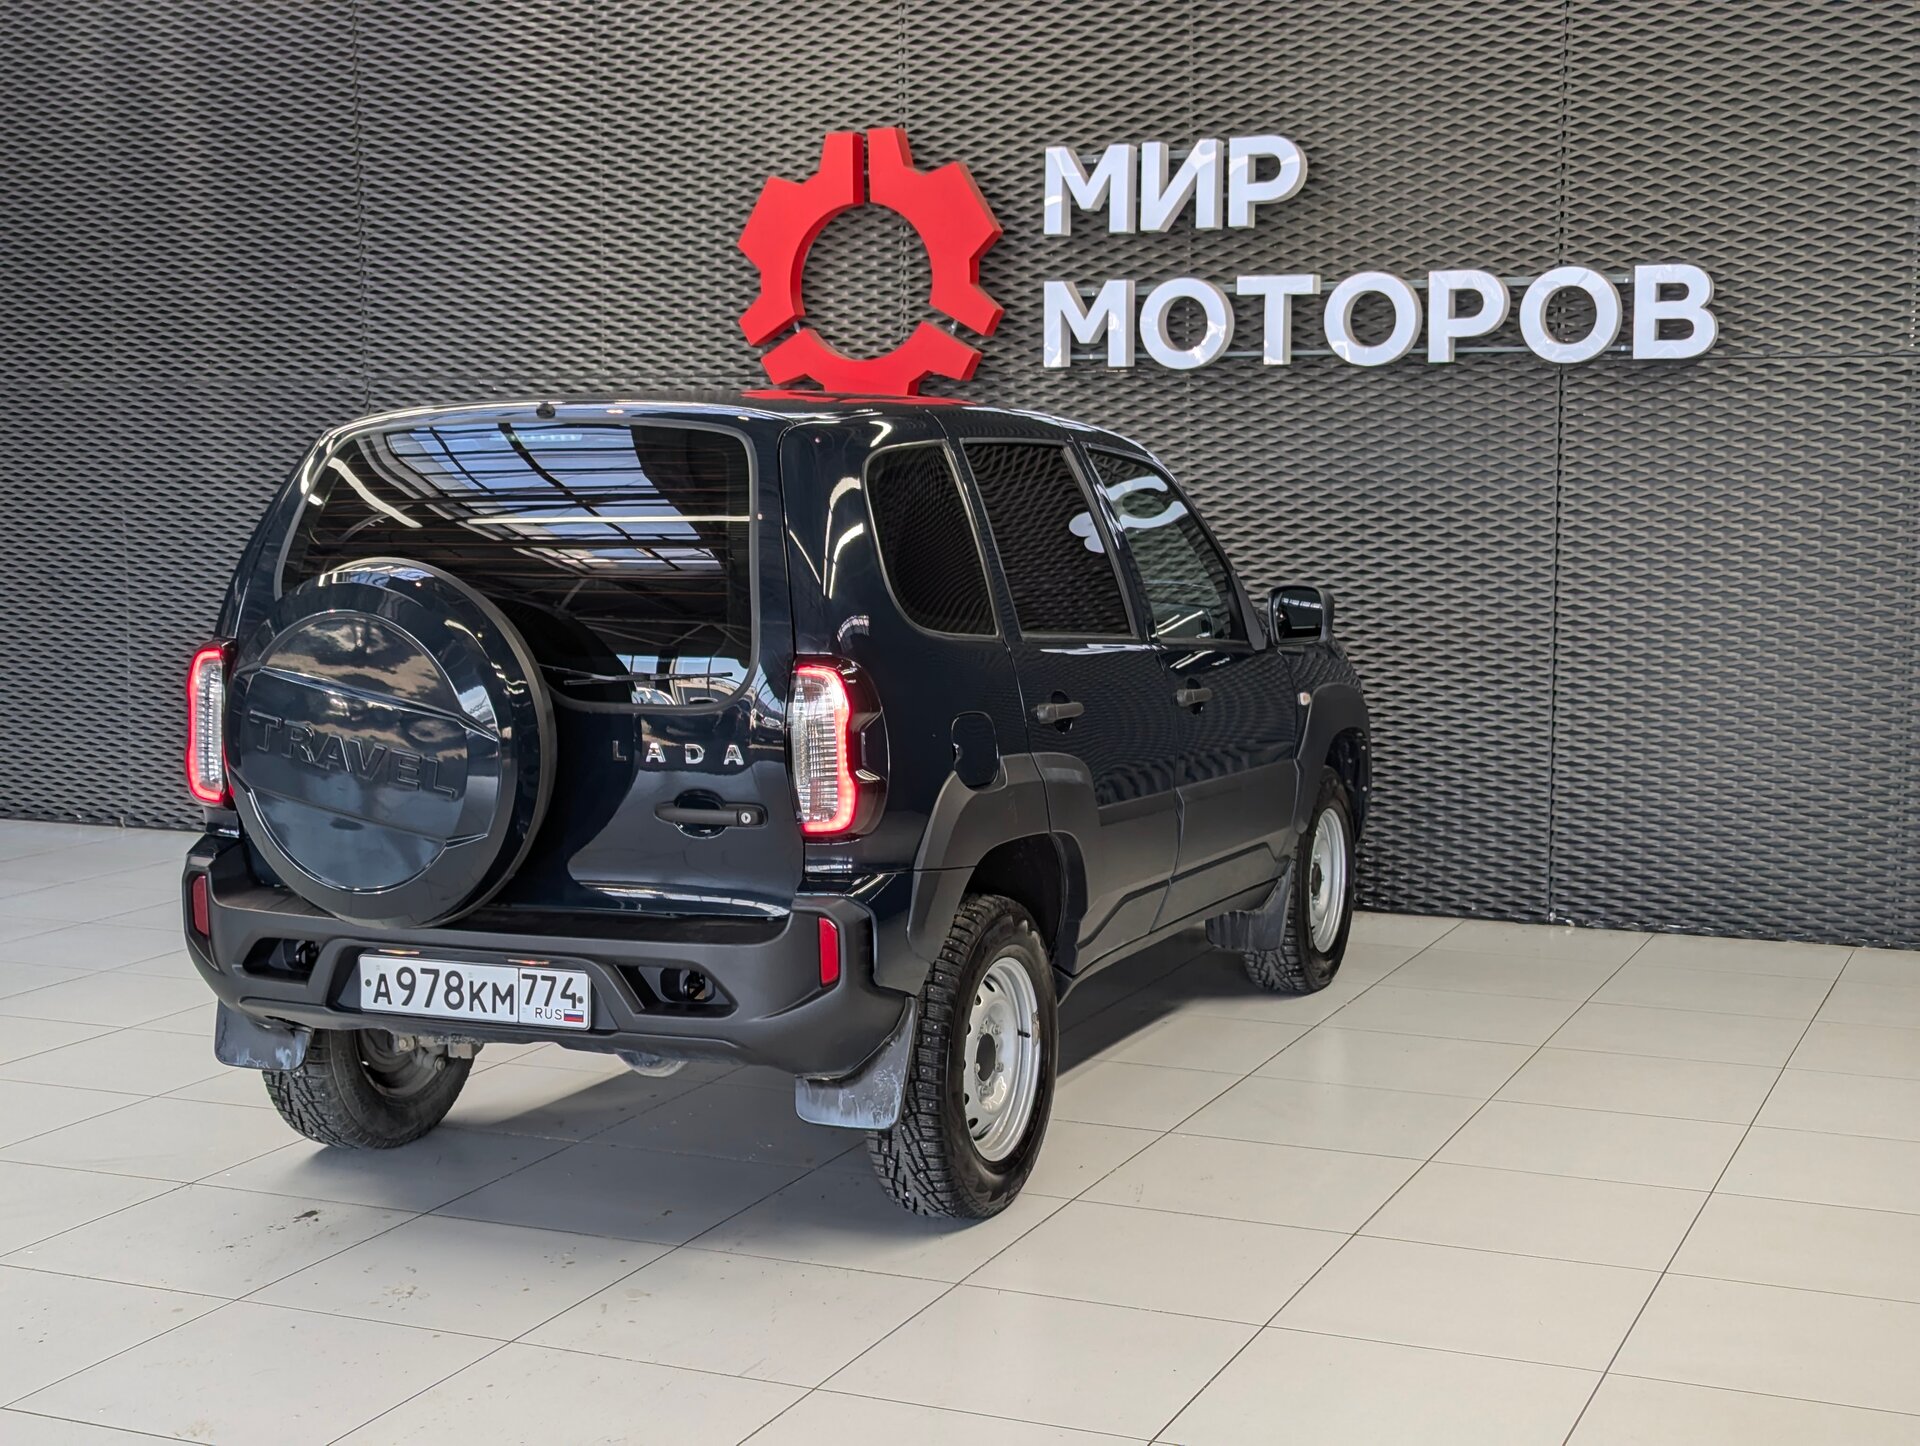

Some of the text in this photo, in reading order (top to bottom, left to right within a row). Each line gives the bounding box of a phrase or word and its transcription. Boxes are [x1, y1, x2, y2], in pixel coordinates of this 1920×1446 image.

[1043, 134, 1308, 236] МИР
[1043, 263, 1719, 370] МОТОРОВ
[247, 709, 458, 799] TRAVEL
[612, 739, 745, 766] LADA
[521, 973, 578, 1009] 774
[534, 1007, 563, 1021] RUS
